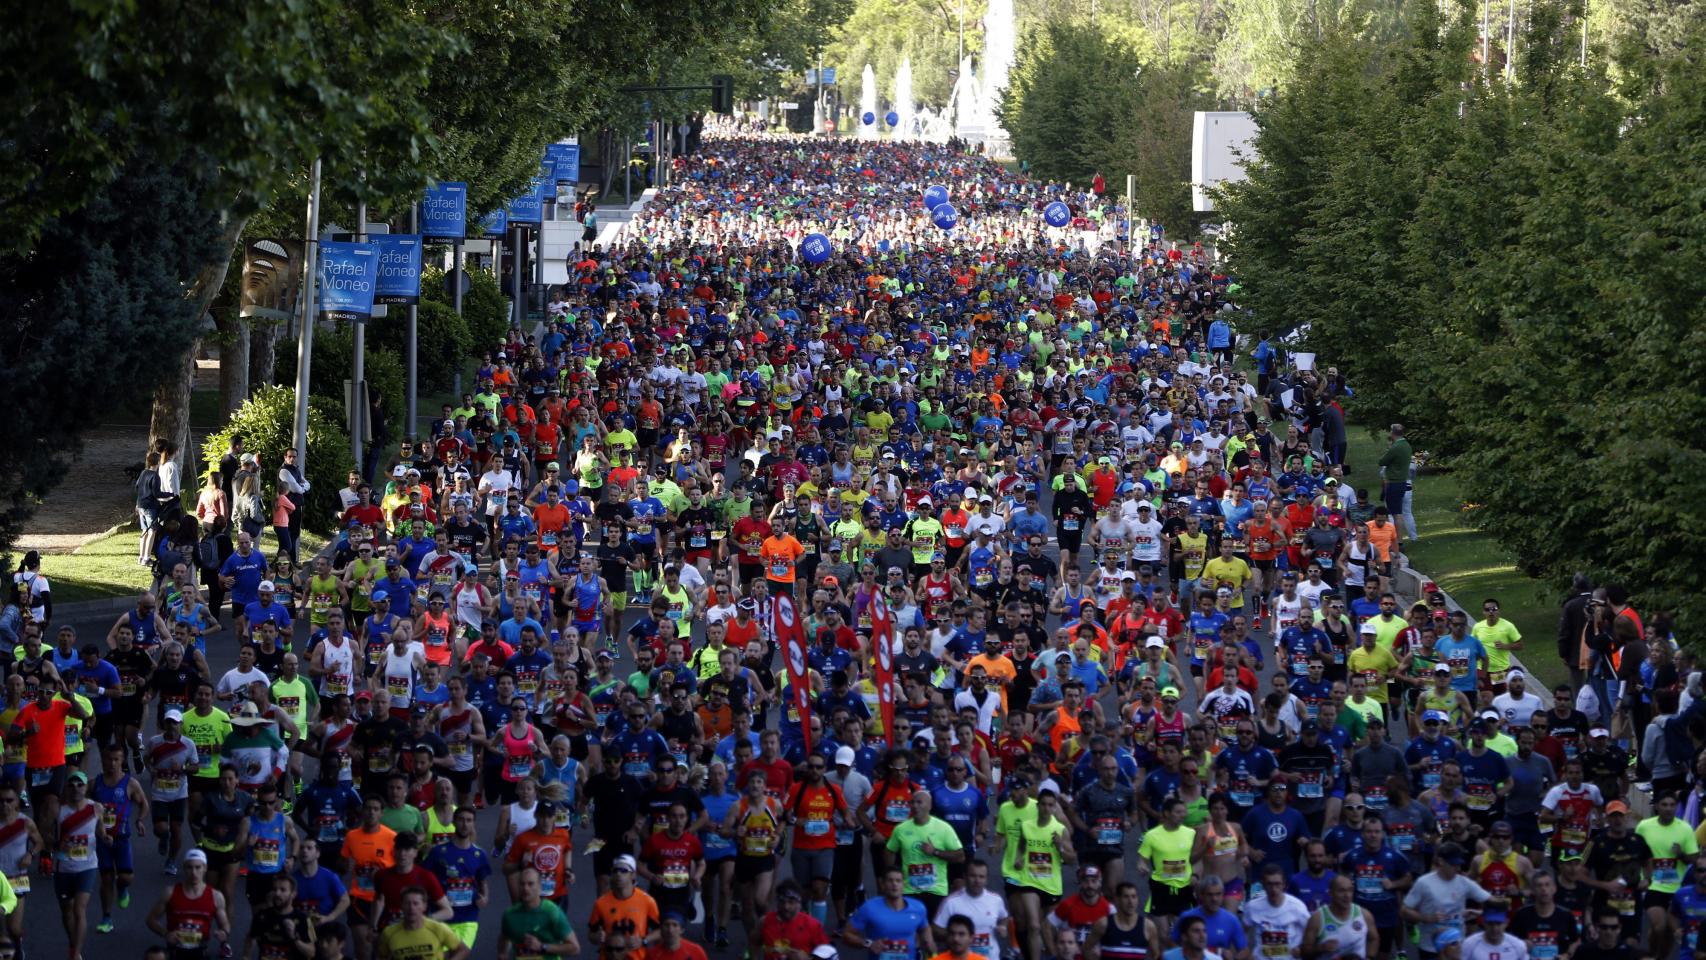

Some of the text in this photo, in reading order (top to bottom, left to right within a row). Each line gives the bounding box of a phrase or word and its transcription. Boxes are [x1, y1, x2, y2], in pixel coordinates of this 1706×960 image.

[556, 162, 577, 170] oneo
[423, 195, 458, 209] Rafael
[423, 208, 462, 221] Moneo
[323, 259, 367, 277] Rafael
[322, 275, 370, 292] Moneo
